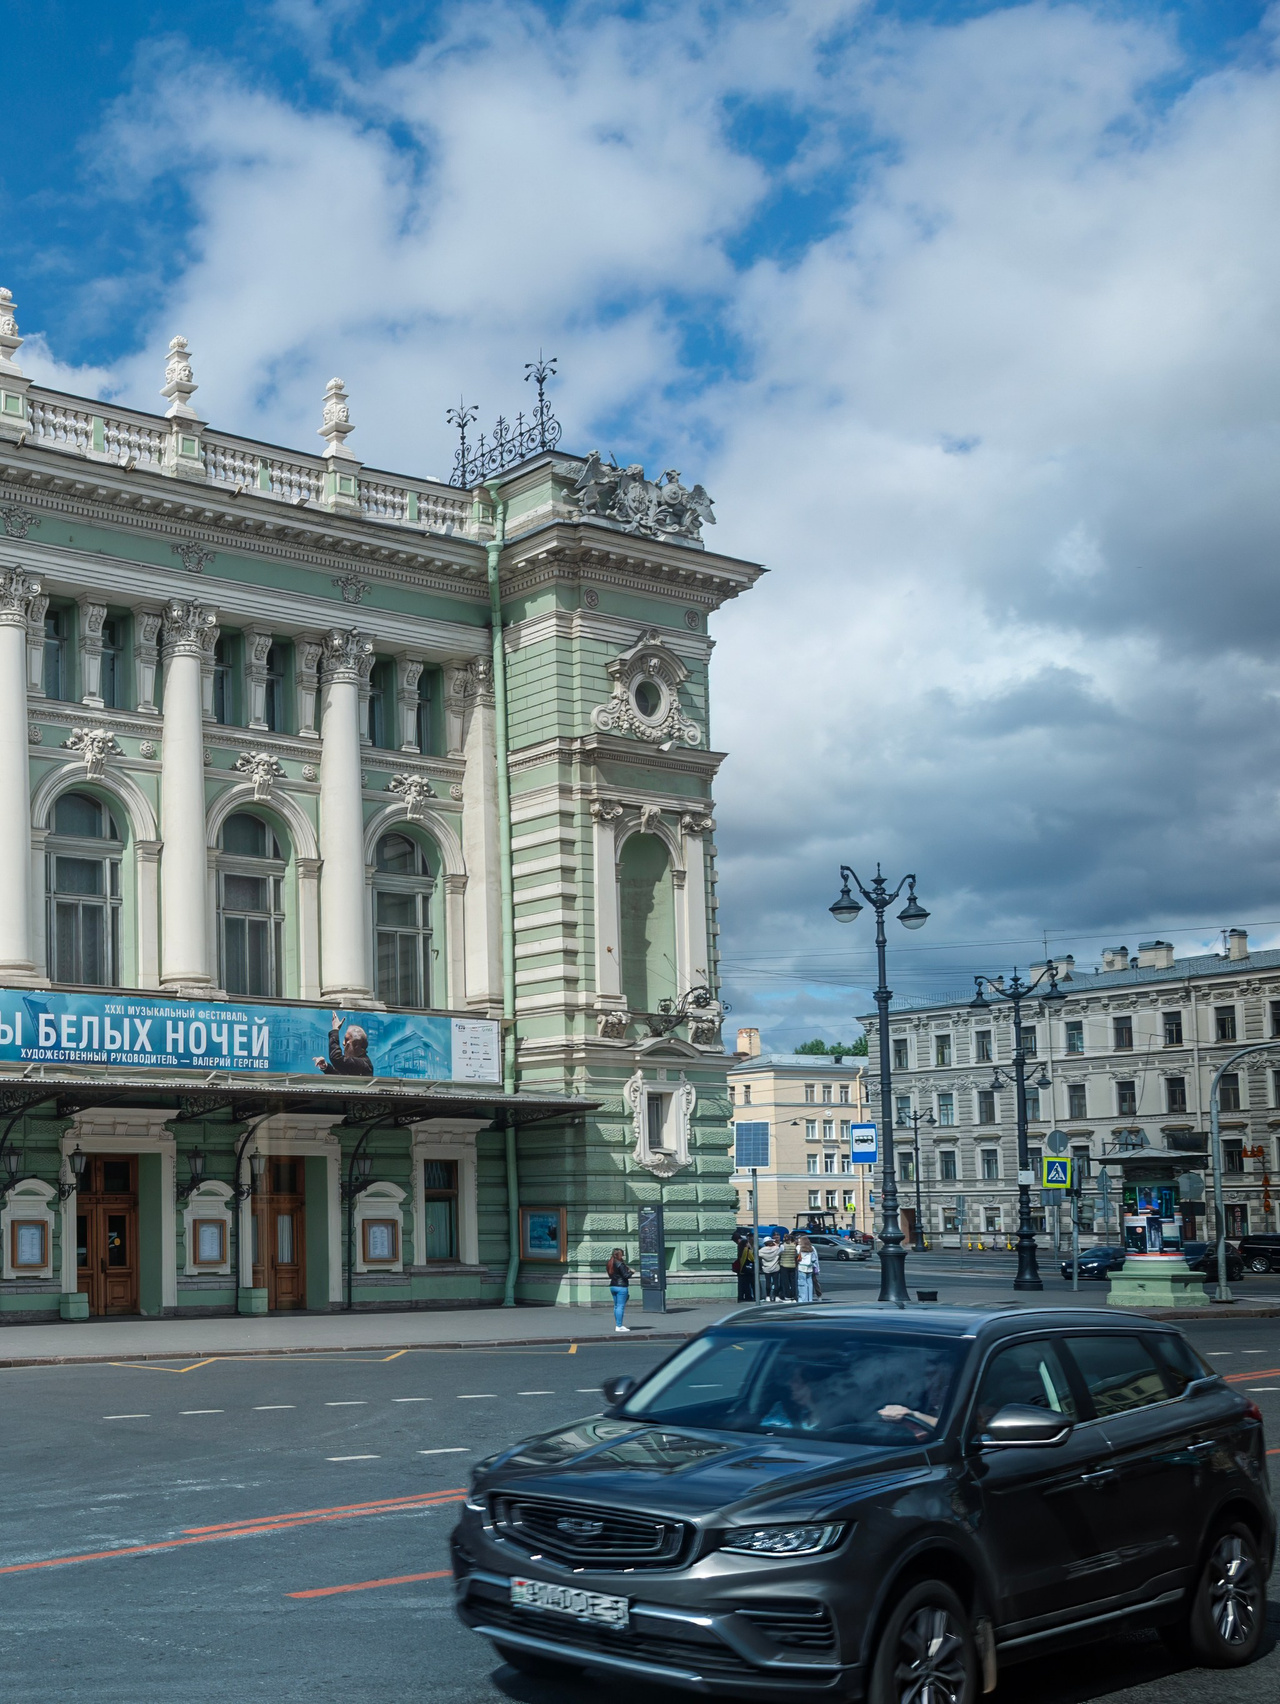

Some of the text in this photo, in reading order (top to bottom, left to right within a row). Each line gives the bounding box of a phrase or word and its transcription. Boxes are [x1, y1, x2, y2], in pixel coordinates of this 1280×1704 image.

[127, 1006, 195, 1019] МУЗЫКАЛЬНЫЙ
[198, 1010, 248, 1021] ФЕСТИВАЛЬ
[38, 1013, 153, 1052] БЕЛЫХ
[166, 1016, 269, 1057] НОЧЕЙ
[20, 1048, 108, 1062] ХУДОЖЕСТВЕННЫЙ
[110, 1052, 178, 1065] РУКОВОДИТЕЛЬ
[192, 1056, 231, 1067] ВАЛЕРИЙ
[233, 1058, 269, 1069] ГЕРГИЕВ
